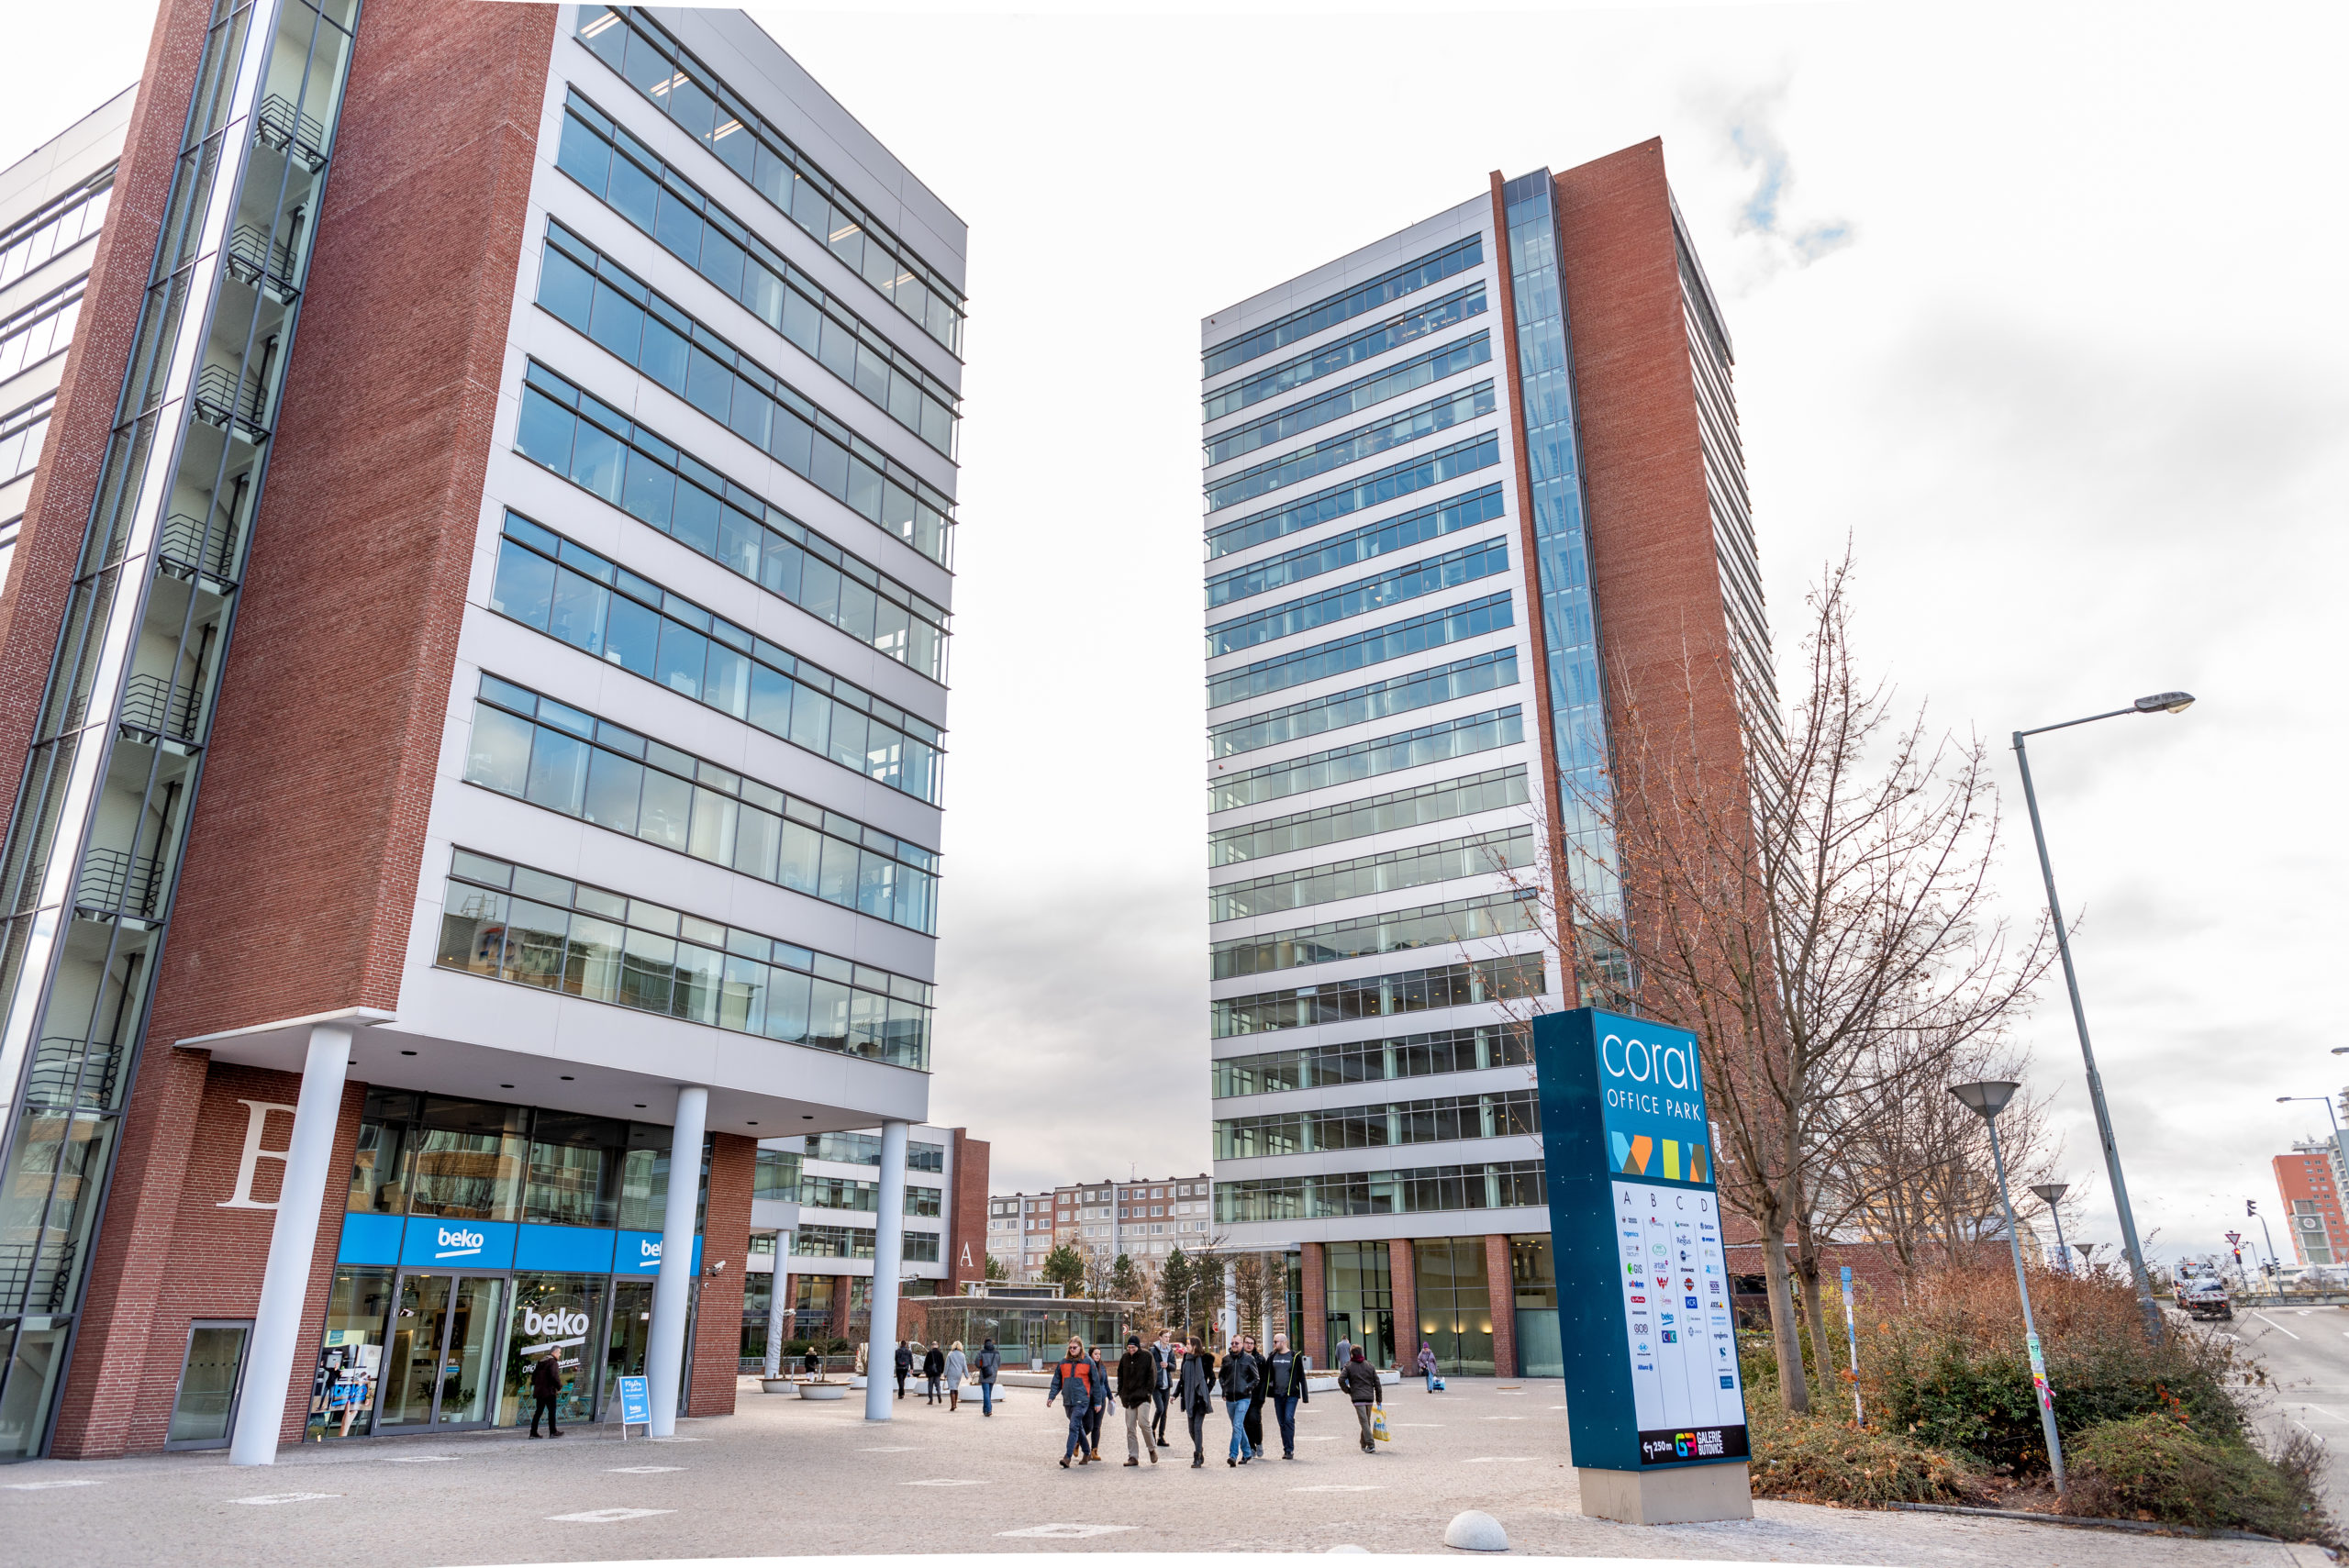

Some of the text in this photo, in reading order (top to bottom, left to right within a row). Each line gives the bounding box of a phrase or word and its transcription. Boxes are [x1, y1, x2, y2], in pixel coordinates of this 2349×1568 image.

[1602, 1034, 1698, 1092] coral
[1608, 1088, 1701, 1121] OFFICE PARK
[1623, 1190, 1708, 1212] A B C D
[438, 1227, 484, 1248] beko
[640, 1239, 662, 1257] be
[960, 1240, 974, 1267] A
[524, 1307, 589, 1336] beko
[1661, 1311, 1674, 1321] beko
[1697, 1430, 1722, 1444] GALERIE
[1698, 1443, 1724, 1456] BUTOVICE
